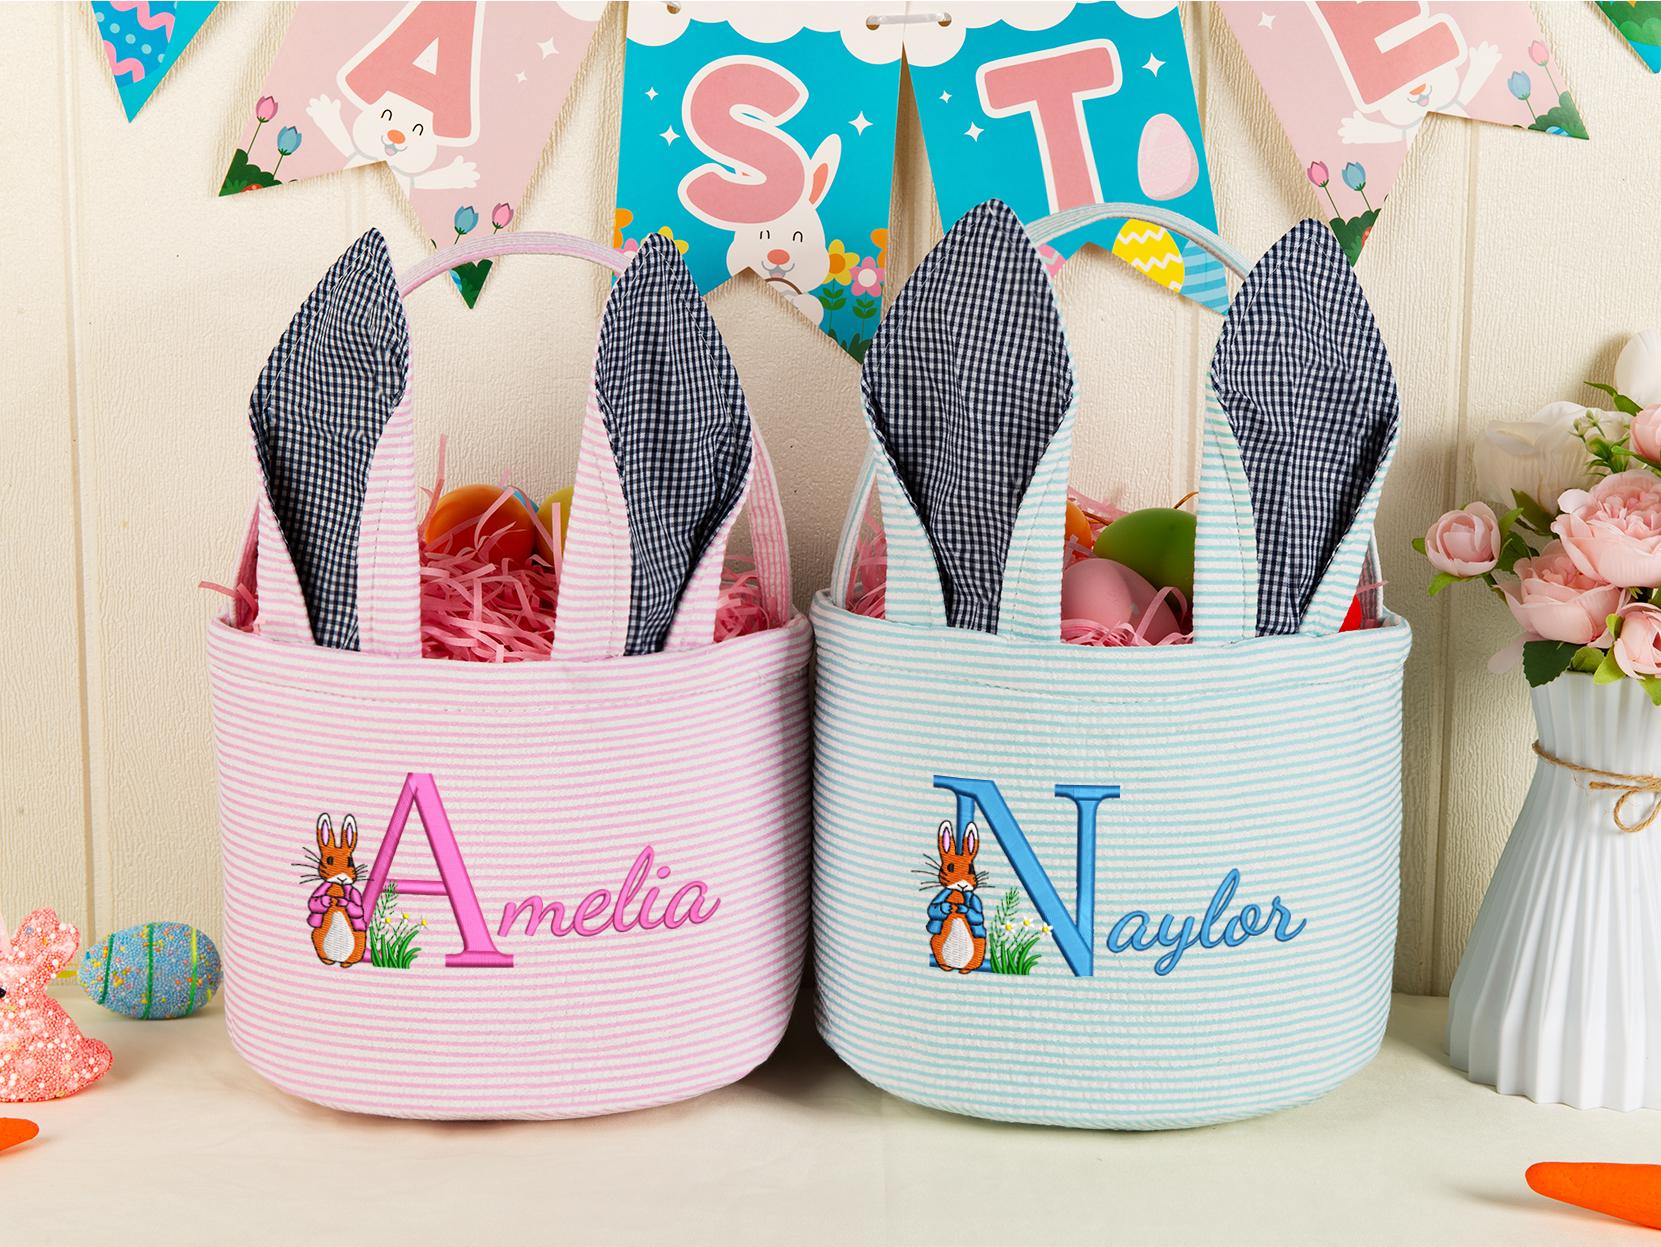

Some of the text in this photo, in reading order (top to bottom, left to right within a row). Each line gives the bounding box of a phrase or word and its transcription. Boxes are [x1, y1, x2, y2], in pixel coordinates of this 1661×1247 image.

[679, 56, 809, 229] S
[976, 38, 1123, 212] T
[361, 772, 721, 968] Amelia
[929, 775, 1307, 977] Naylor
